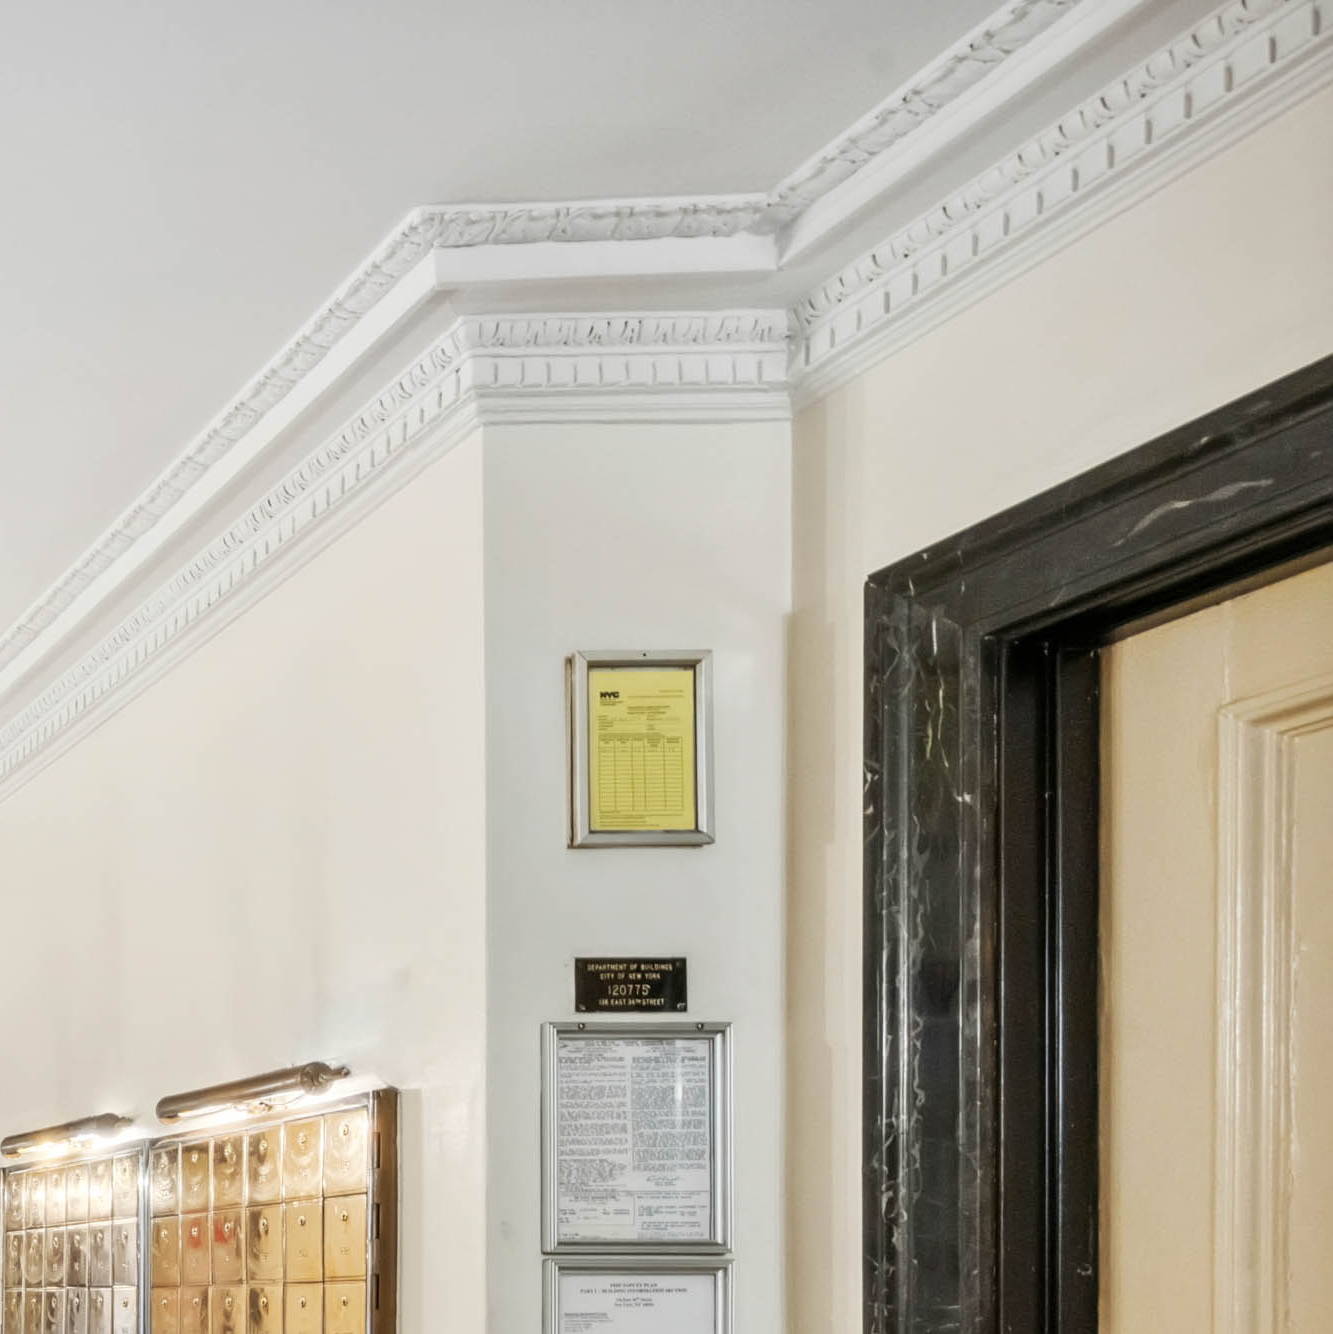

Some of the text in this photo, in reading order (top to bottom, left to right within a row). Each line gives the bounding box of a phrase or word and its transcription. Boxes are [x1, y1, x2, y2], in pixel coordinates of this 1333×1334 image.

[599, 691, 620, 699] NYC
[587, 963, 673, 971] DEPARTMENT OF BUILDINGS
[607, 984, 651, 996] 120775
[611, 998, 626, 1006] EAST
[642, 998, 665, 1006] STREET
